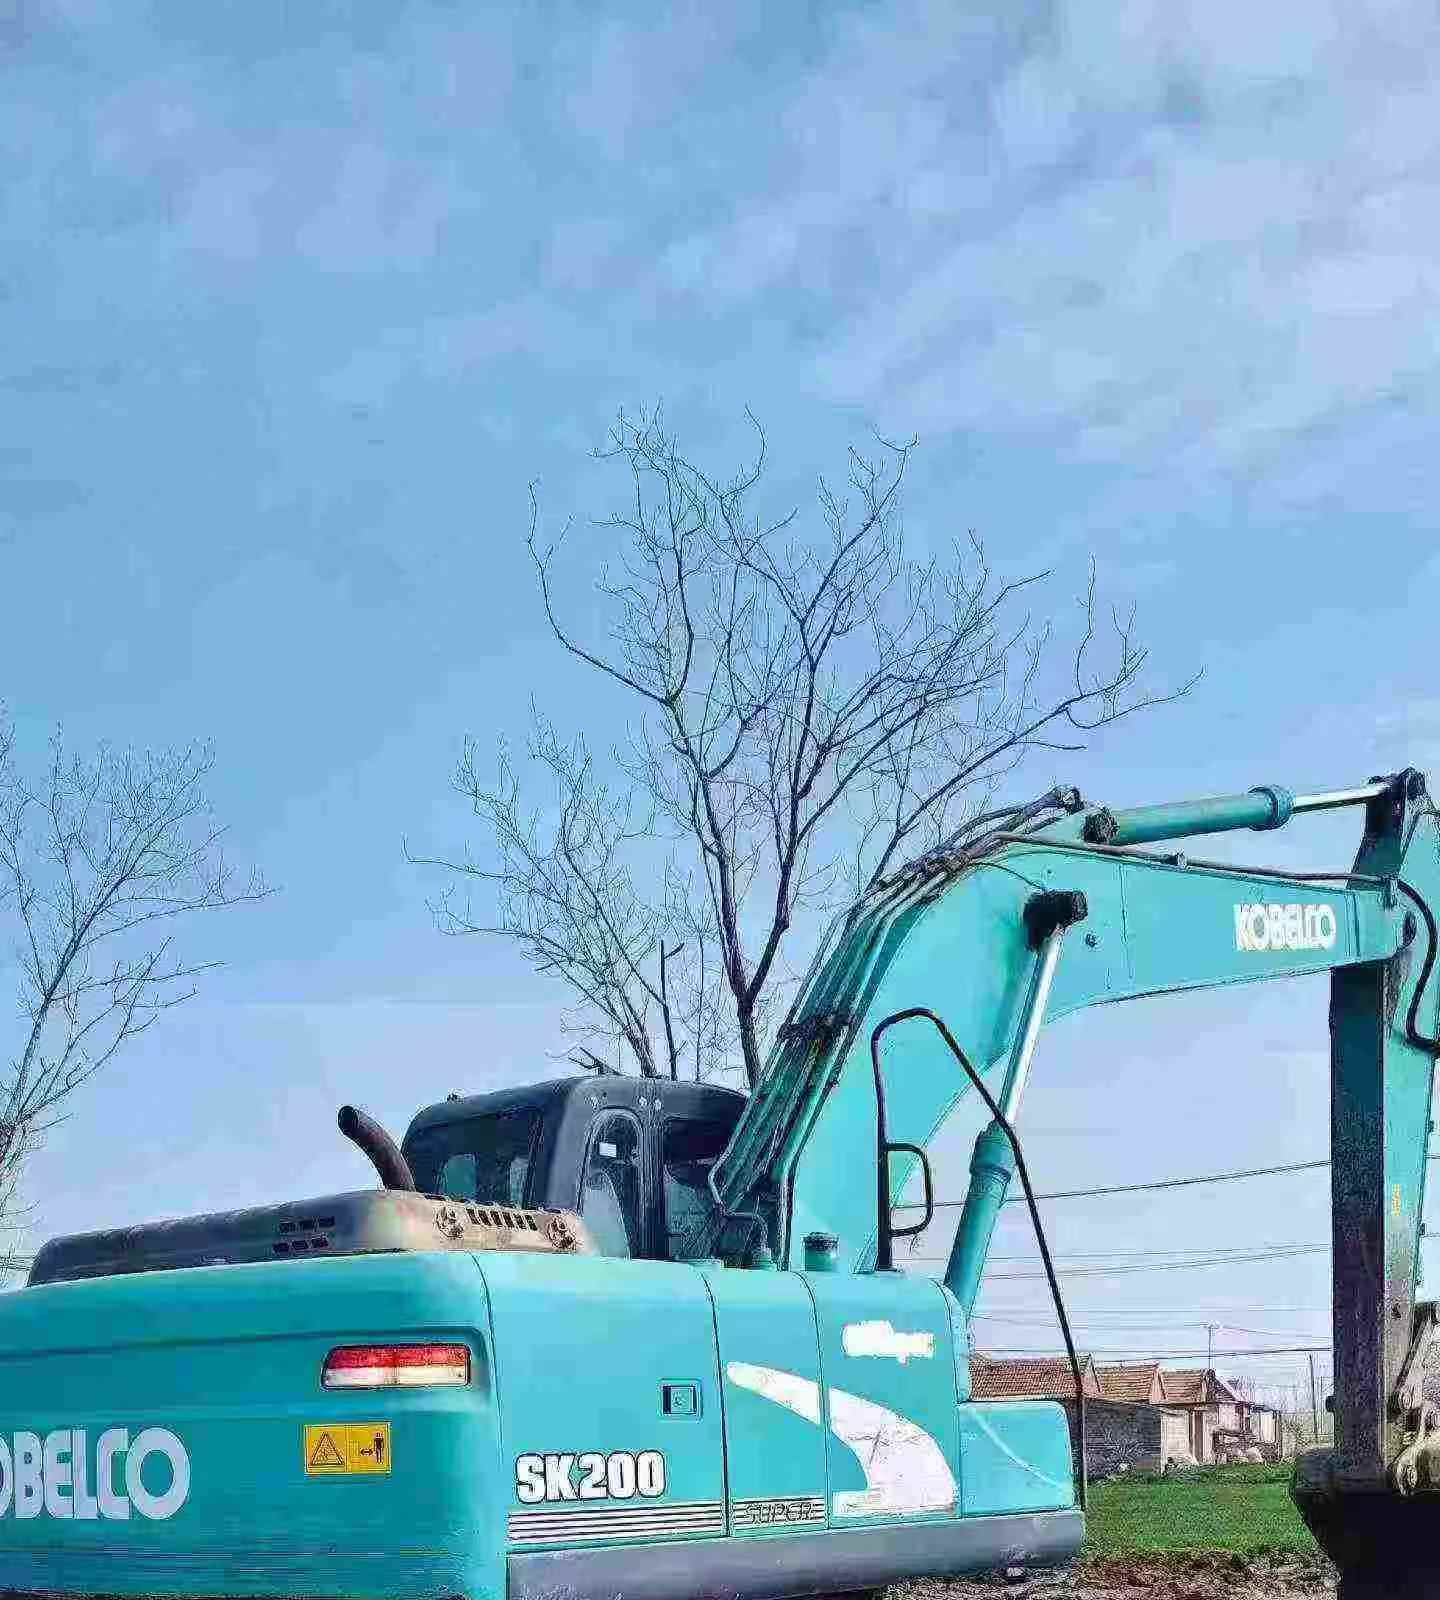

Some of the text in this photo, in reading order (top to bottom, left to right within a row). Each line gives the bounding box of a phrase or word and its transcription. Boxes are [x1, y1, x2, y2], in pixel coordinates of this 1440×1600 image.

[1234, 903, 1336, 950] KOBELCO
[0, 1427, 191, 1519] BELCO
[516, 1450, 666, 1503] SK200
